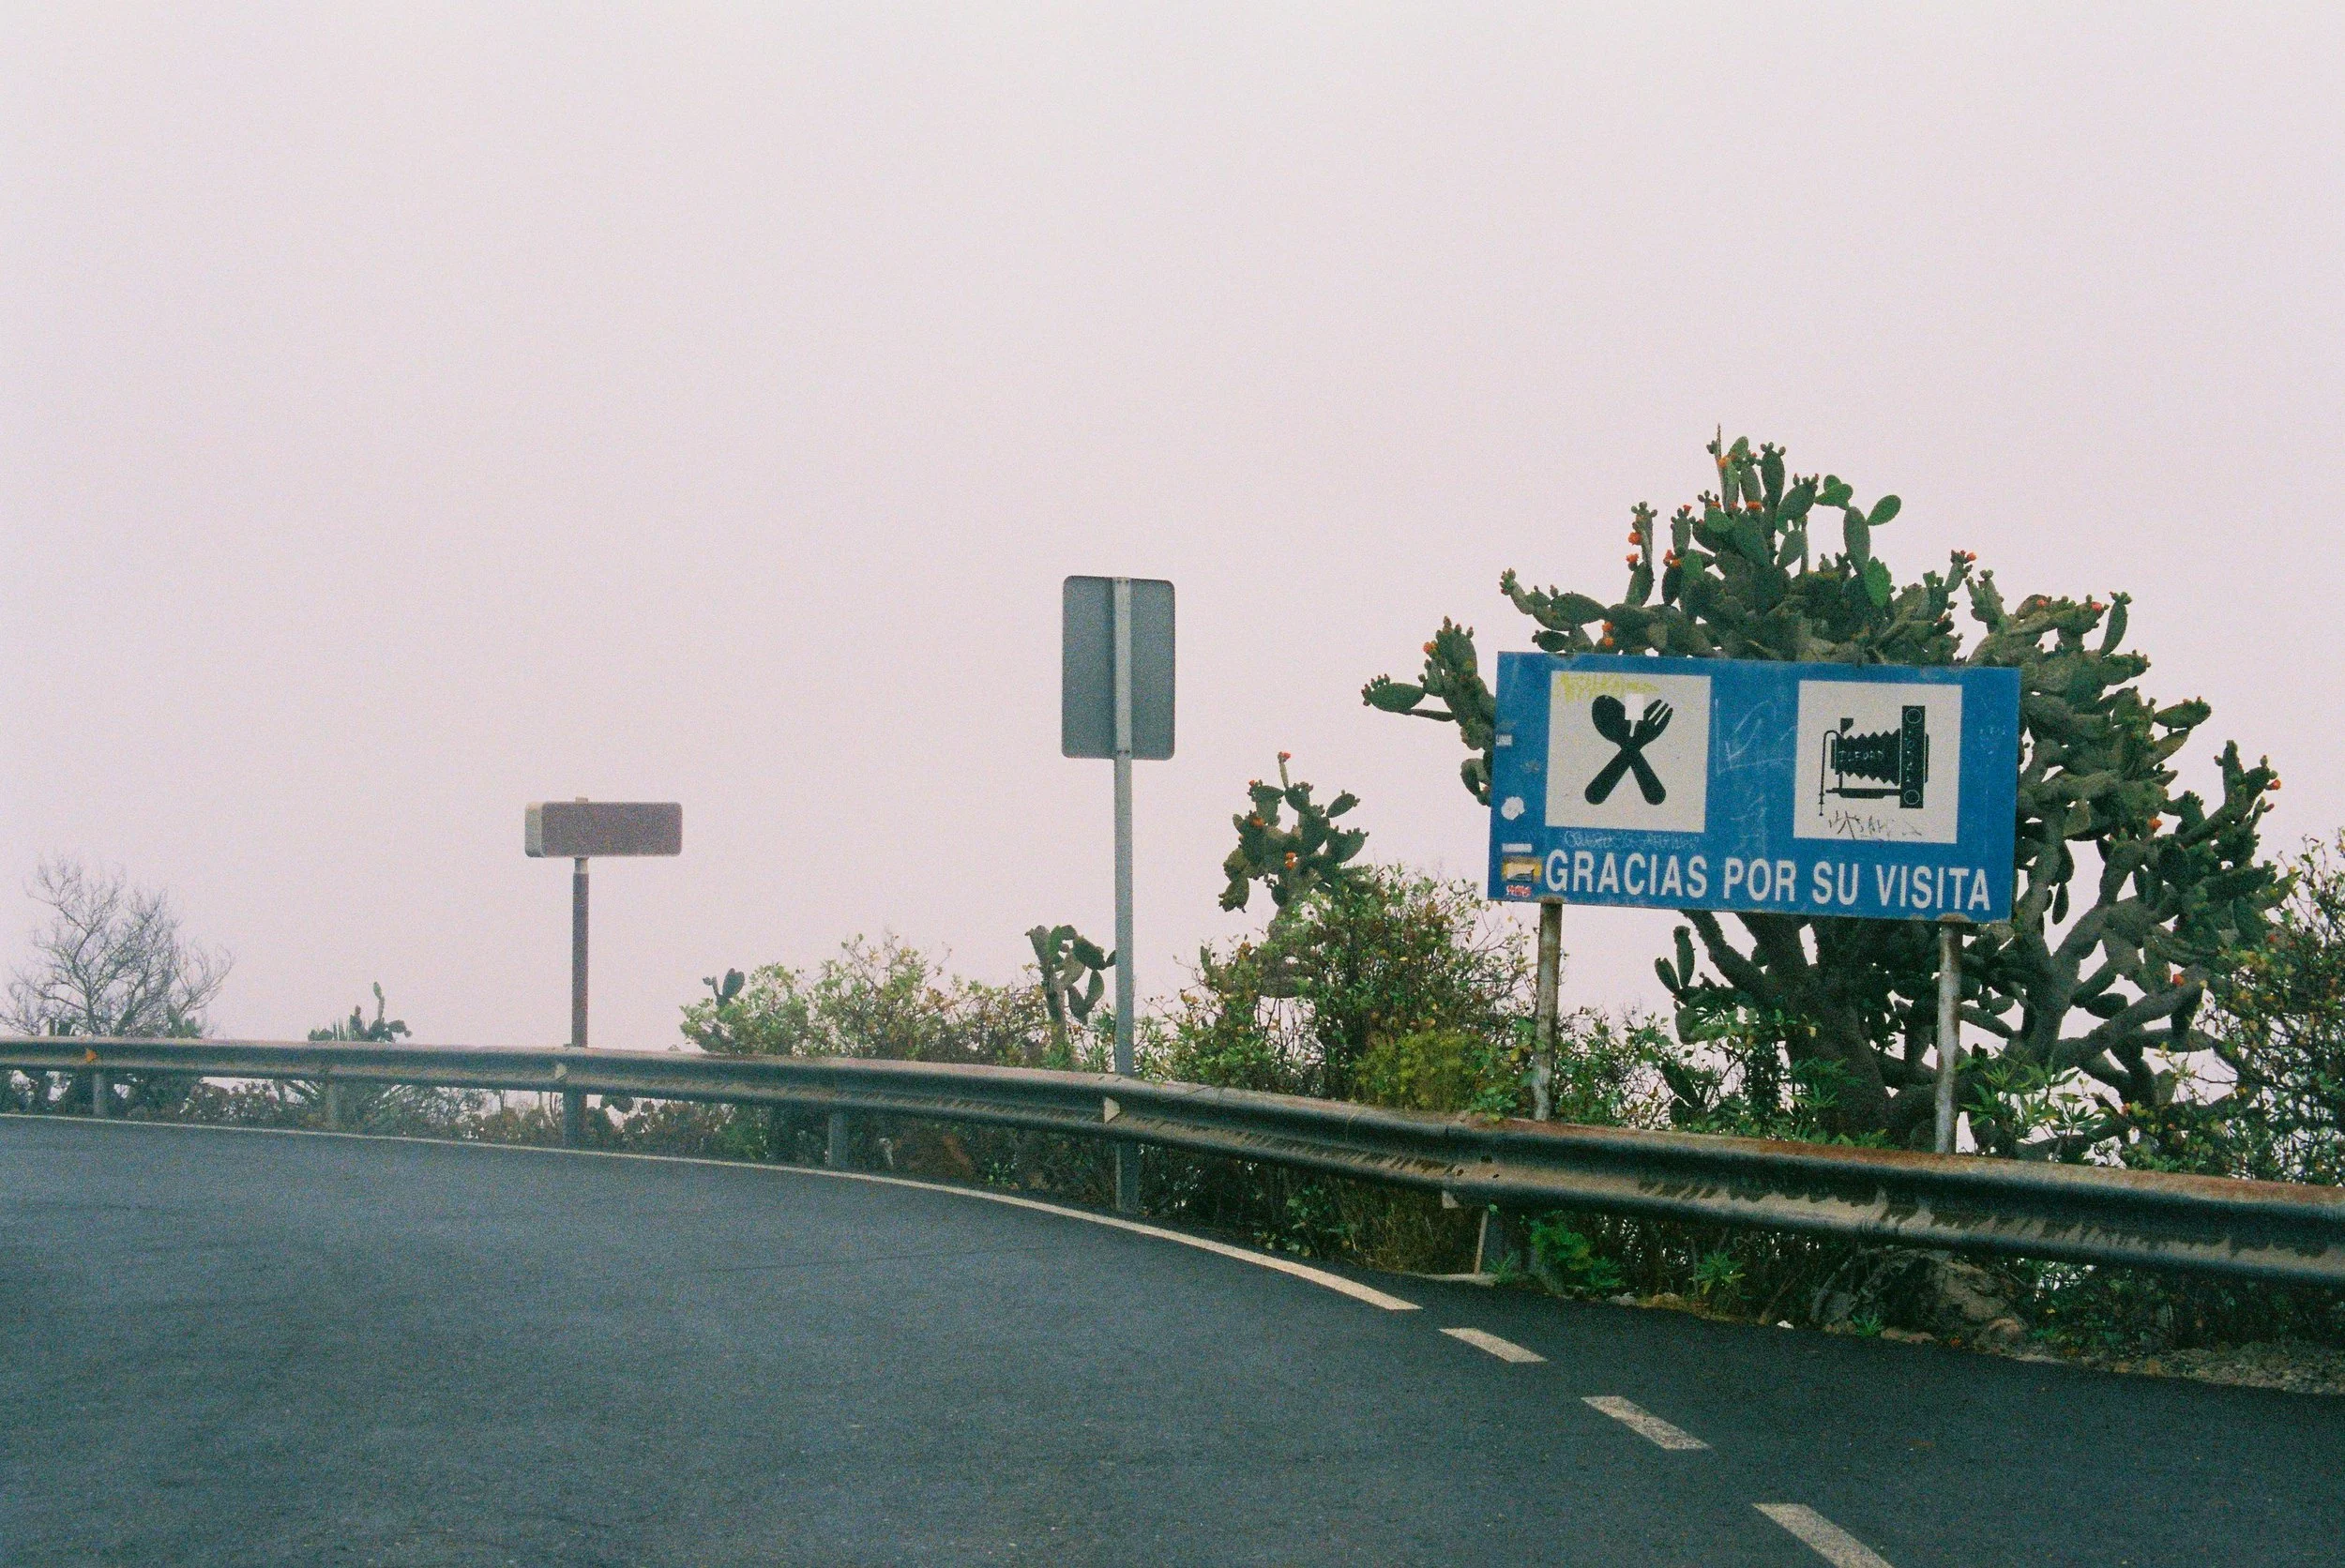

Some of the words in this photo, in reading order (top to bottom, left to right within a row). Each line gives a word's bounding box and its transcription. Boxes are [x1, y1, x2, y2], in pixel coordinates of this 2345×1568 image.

[1546, 849, 1707, 898] GRACIAS
[1723, 857, 1796, 901] POR
[1812, 861, 1858, 905] SU
[1876, 864, 1990, 911] VISITA
